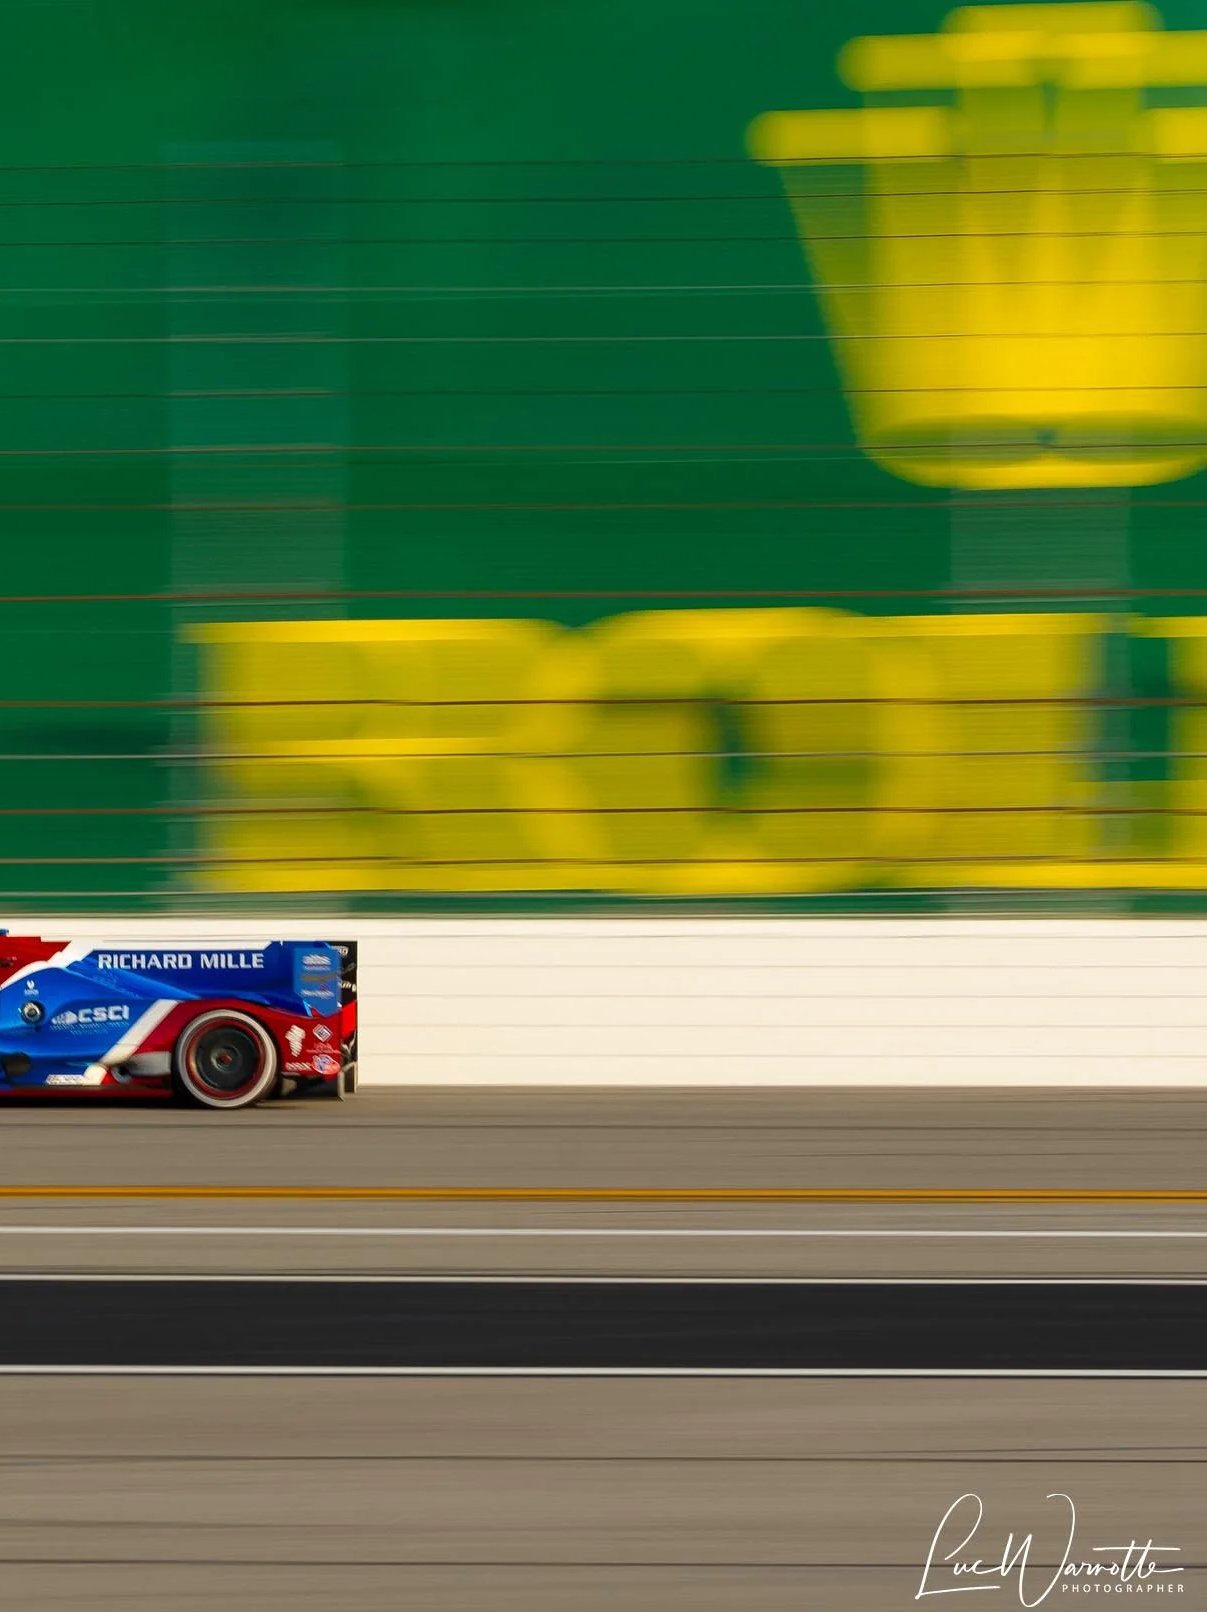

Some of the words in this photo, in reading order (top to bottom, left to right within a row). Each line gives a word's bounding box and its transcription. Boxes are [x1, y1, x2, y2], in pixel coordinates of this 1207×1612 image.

[98, 953, 192, 970] RICHARD
[200, 953, 264, 969] MILLE
[78, 1005, 130, 1023] CSCI
